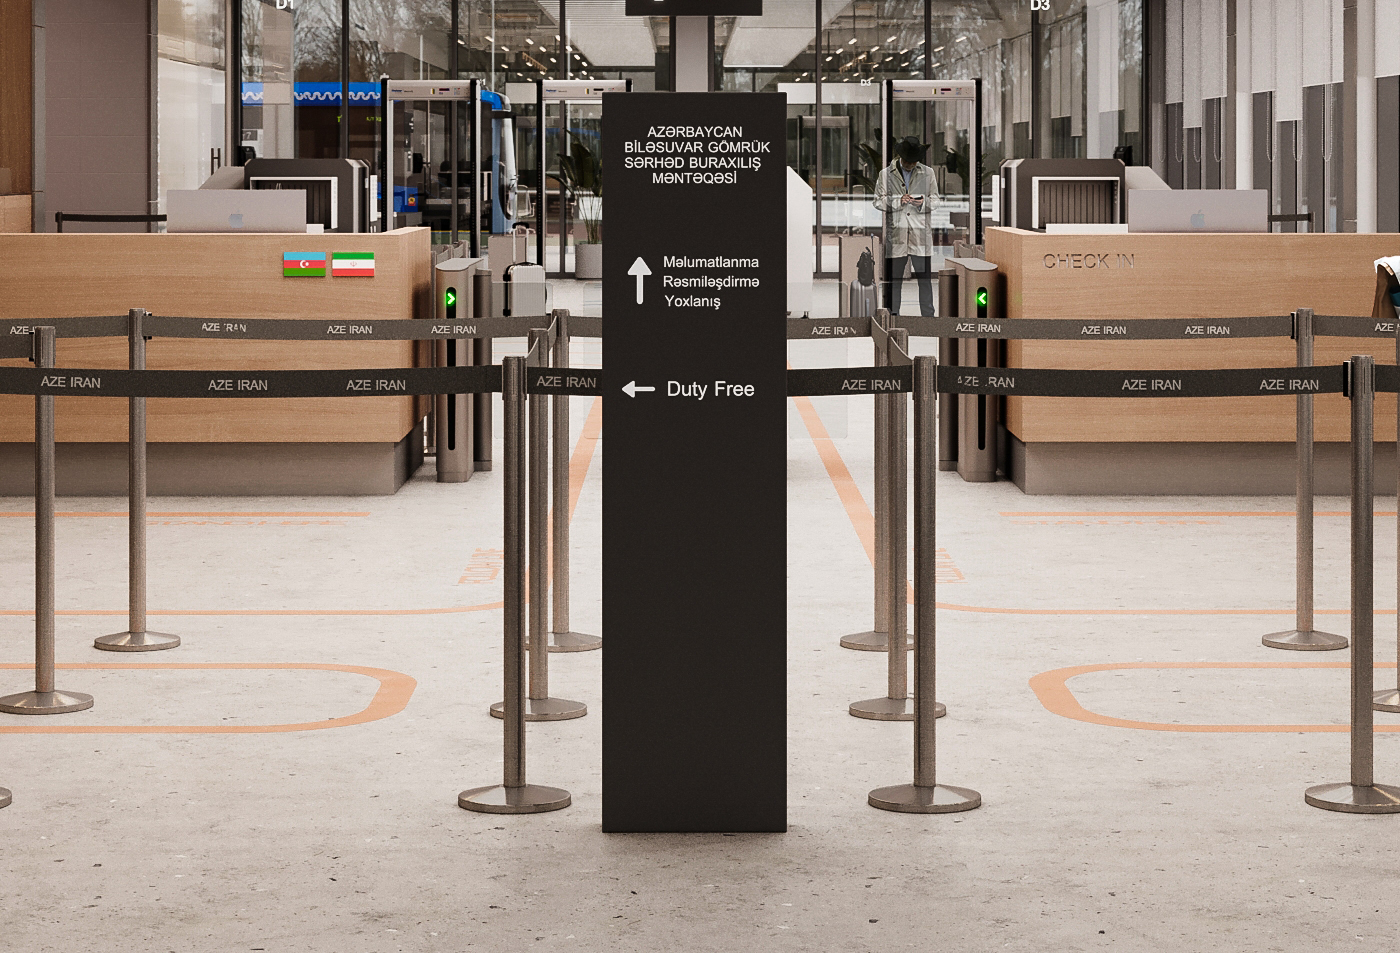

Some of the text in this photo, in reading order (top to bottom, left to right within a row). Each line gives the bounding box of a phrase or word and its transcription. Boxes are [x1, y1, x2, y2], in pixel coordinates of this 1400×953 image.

[860, 78, 872, 87] D3
[647, 126, 743, 139] AZƏRBAYCAN
[624, 139, 771, 153] BİLƏSUVAR GÖMRÜK
[624, 157, 762, 172] SƏRHƏD BURAXILIŞ
[652, 170, 738, 185] MƏNTƏQƏSİ
[663, 256, 760, 269] Məlumatlanma
[1043, 253, 1135, 269] CHECK IN
[663, 275, 760, 291] Rəsmiləşdirmə
[665, 295, 721, 310] Yoxlanış
[10, 326, 29, 334] AZE
[202, 323, 220, 332] AZE
[327, 325, 372, 334] AZE IRAN
[431, 325, 476, 334] AZE IRAN
[812, 327, 830, 335] AZE
[956, 324, 1001, 333] AZE IRAN
[1081, 326, 1126, 334] AZE IRAN
[1185, 326, 1230, 335] AZE IRAN
[1375, 323, 1394, 332] AZE
[41, 376, 100, 388] AZE IRAN
[208, 380, 267, 390] AZE IRAN
[347, 380, 406, 390] AZE IRAN
[537, 376, 596, 388] AZE IRAN
[842, 380, 900, 390] AZE IRAN
[1122, 380, 1181, 390] AZE IRAN
[1260, 379, 1319, 390] AZE IRAN
[667, 380, 755, 400] Duty Free
